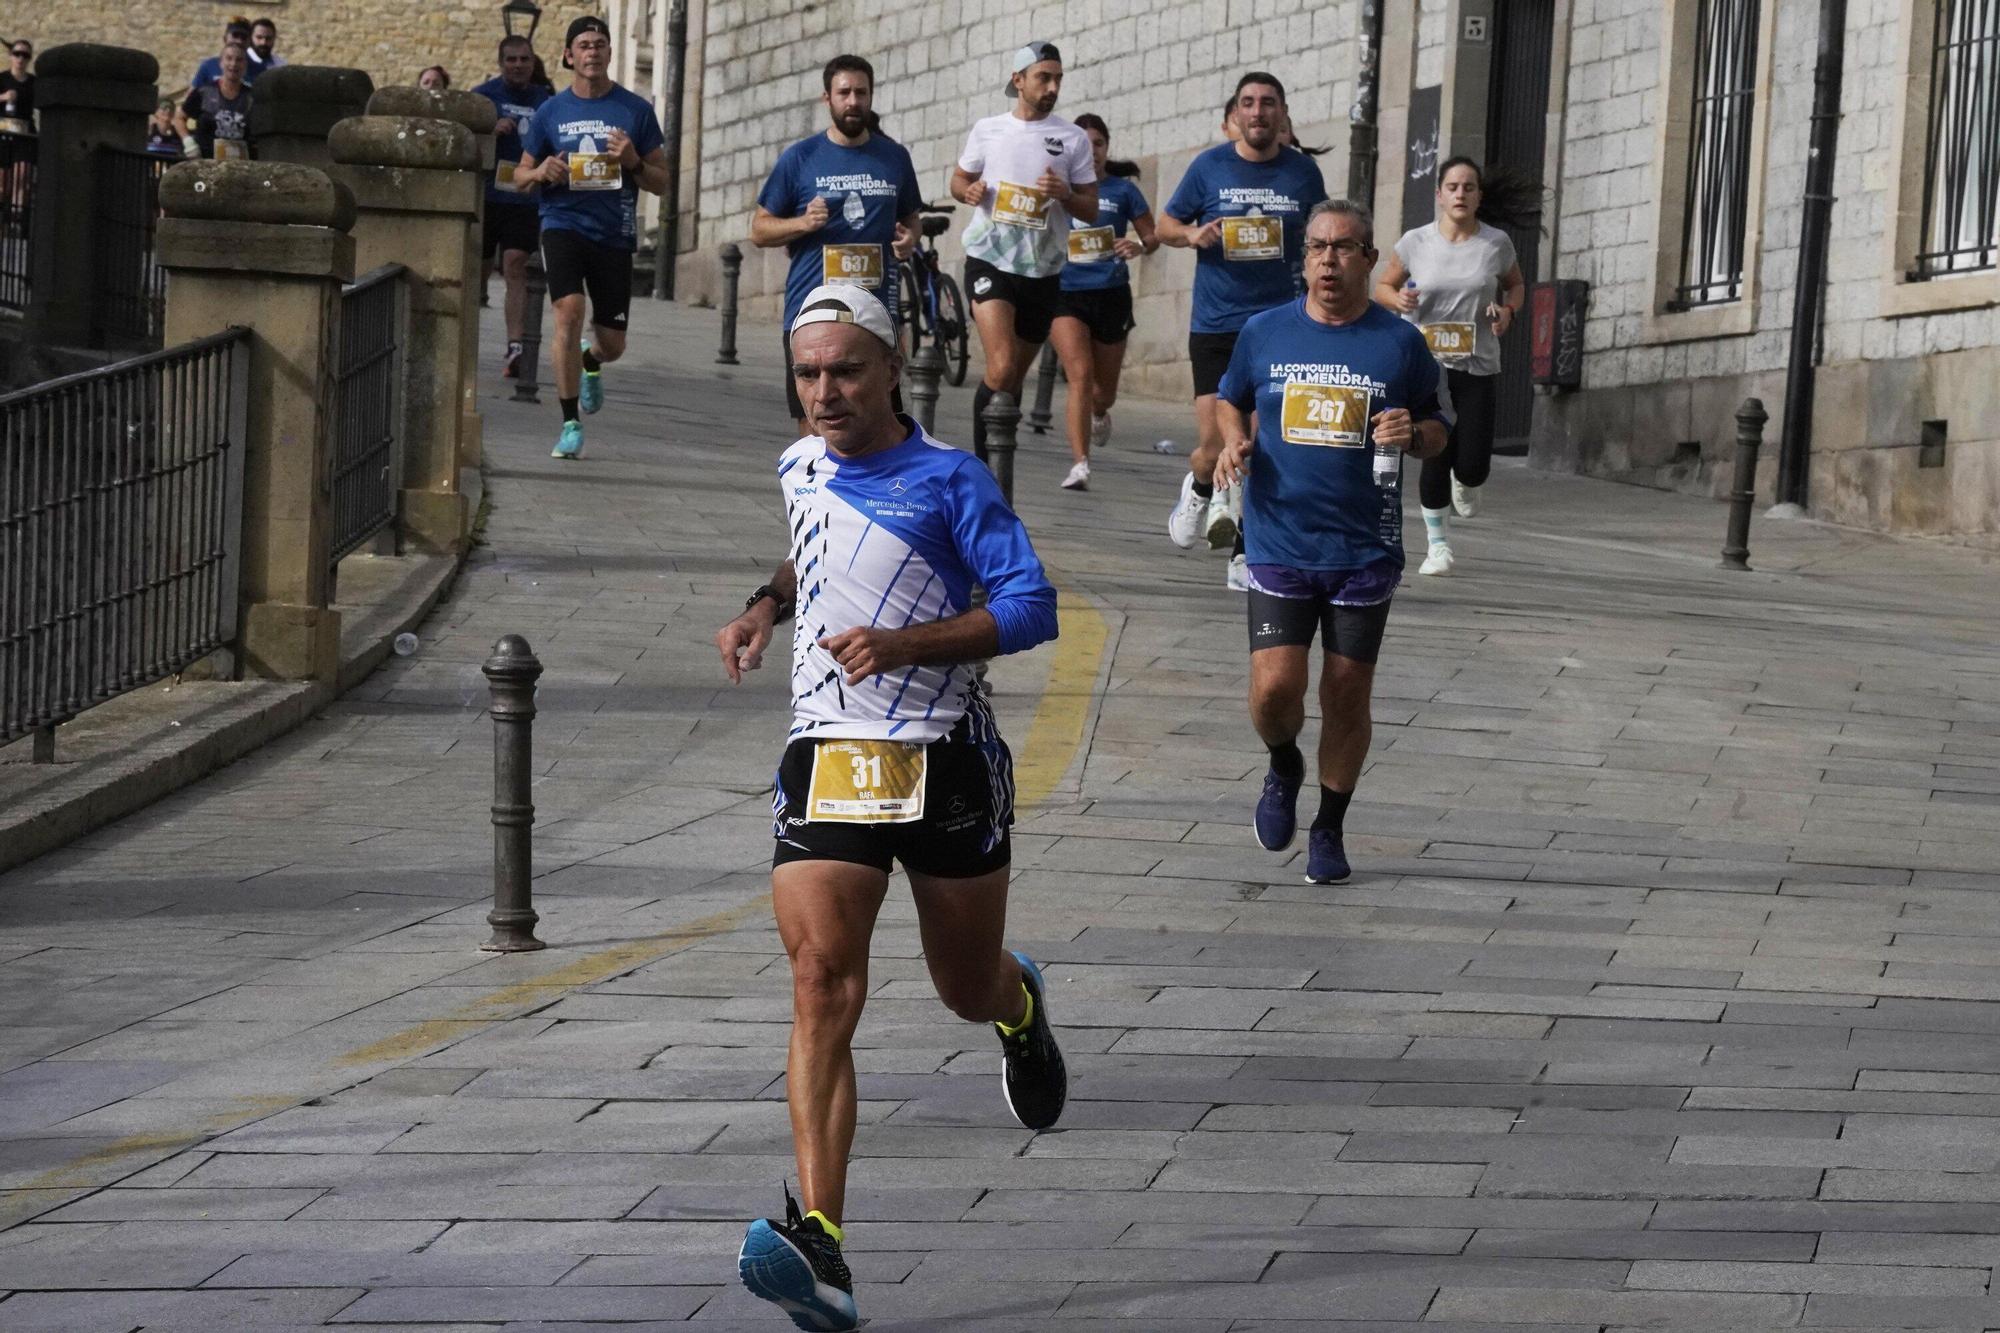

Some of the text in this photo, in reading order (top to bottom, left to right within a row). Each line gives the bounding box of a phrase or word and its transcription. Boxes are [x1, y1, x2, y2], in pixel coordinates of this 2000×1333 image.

[816, 174, 872, 184] LA CONQUISTA
[829, 179, 888, 191] ALMENDRA
[1229, 188, 1274, 196] CONQUISTA
[1231, 194, 1290, 204] ALMENDRA
[841, 255, 869, 273] 637
[1434, 332, 1459, 347] 709
[1270, 363, 1349, 374] LA CONQUISTA
[1285, 372, 1372, 386] ALMENDRA
[1306, 398, 1346, 424] 267
[794, 486, 818, 496] KON
[865, 499, 928, 512] Mercedes-Benz
[851, 755, 881, 789] 31
